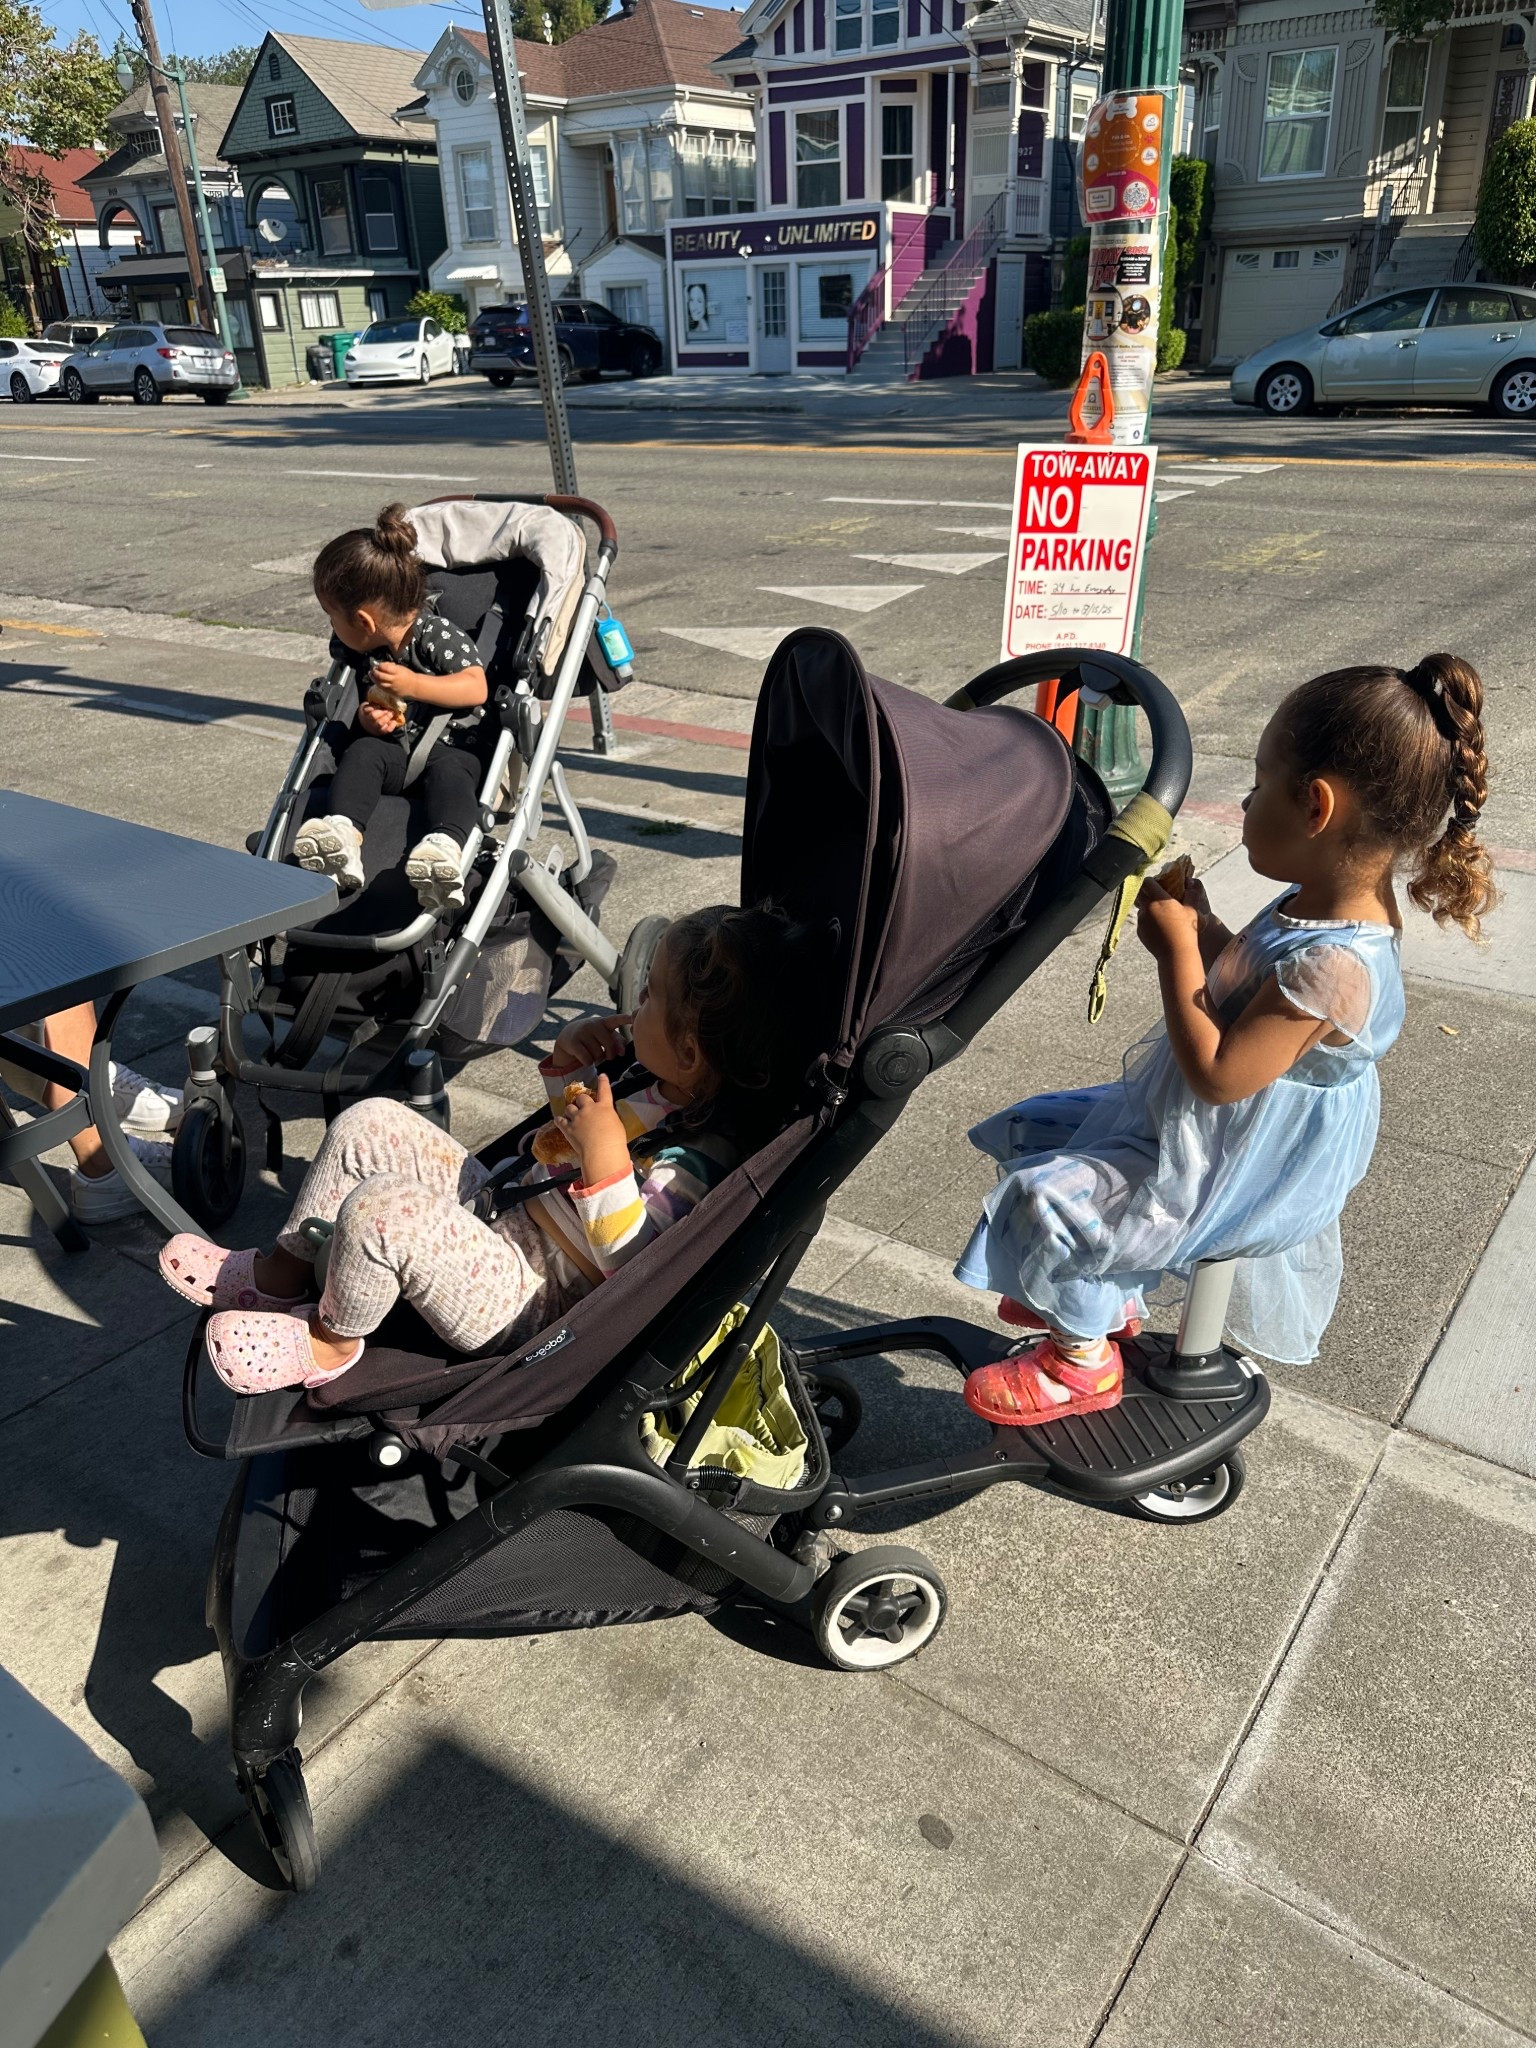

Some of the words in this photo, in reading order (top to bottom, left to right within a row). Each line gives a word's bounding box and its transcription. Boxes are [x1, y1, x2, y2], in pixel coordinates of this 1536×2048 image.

[674, 230, 742, 252] BEAUTY
[777, 220, 877, 246] UNLIMITED
[1031, 454, 1143, 479] TOW-AWAY
[1025, 485, 1075, 528] NO
[1020, 538, 1132, 572] PARKING
[1018, 580, 1047, 595] TIME:
[1015, 604, 1047, 619] DATE:
